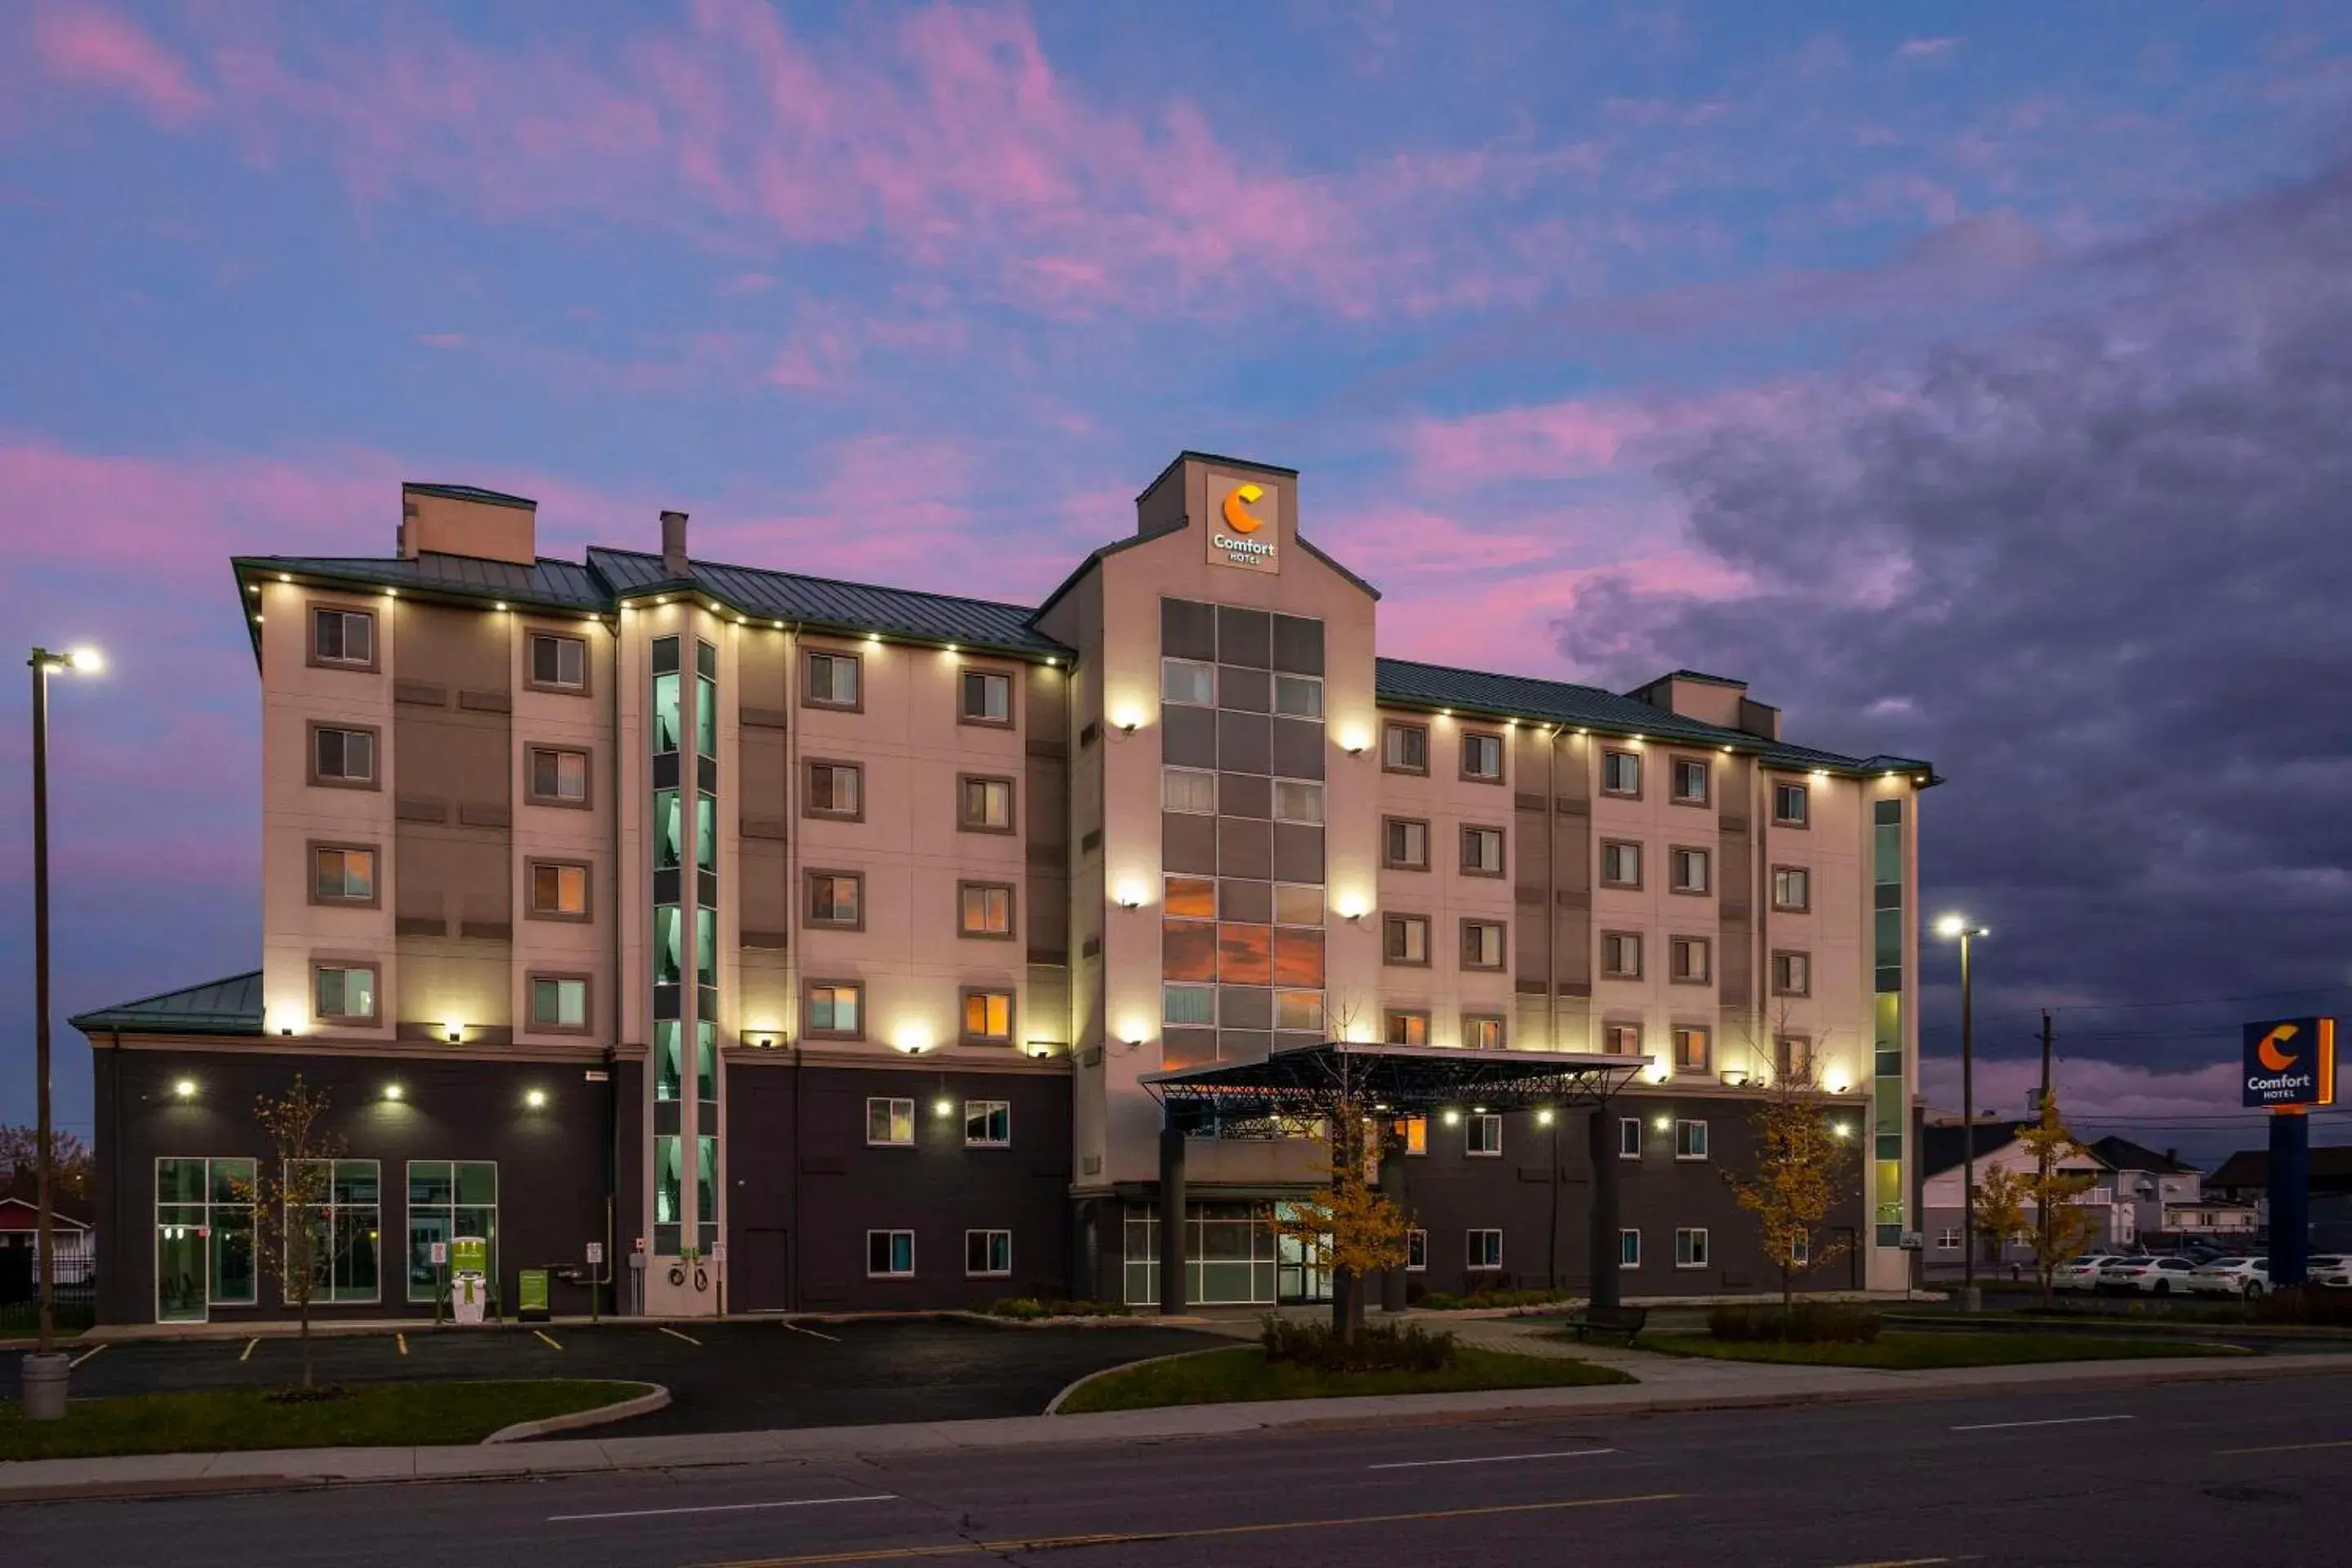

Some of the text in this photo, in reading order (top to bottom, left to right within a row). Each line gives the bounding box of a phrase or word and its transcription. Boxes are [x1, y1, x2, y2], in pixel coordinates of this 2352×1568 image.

[1214, 533, 1274, 555] Comfort
[1230, 553, 1259, 564] HOTEL
[2247, 1074, 2310, 1089] Comfort
[2263, 1090, 2295, 1098] HOTEL
